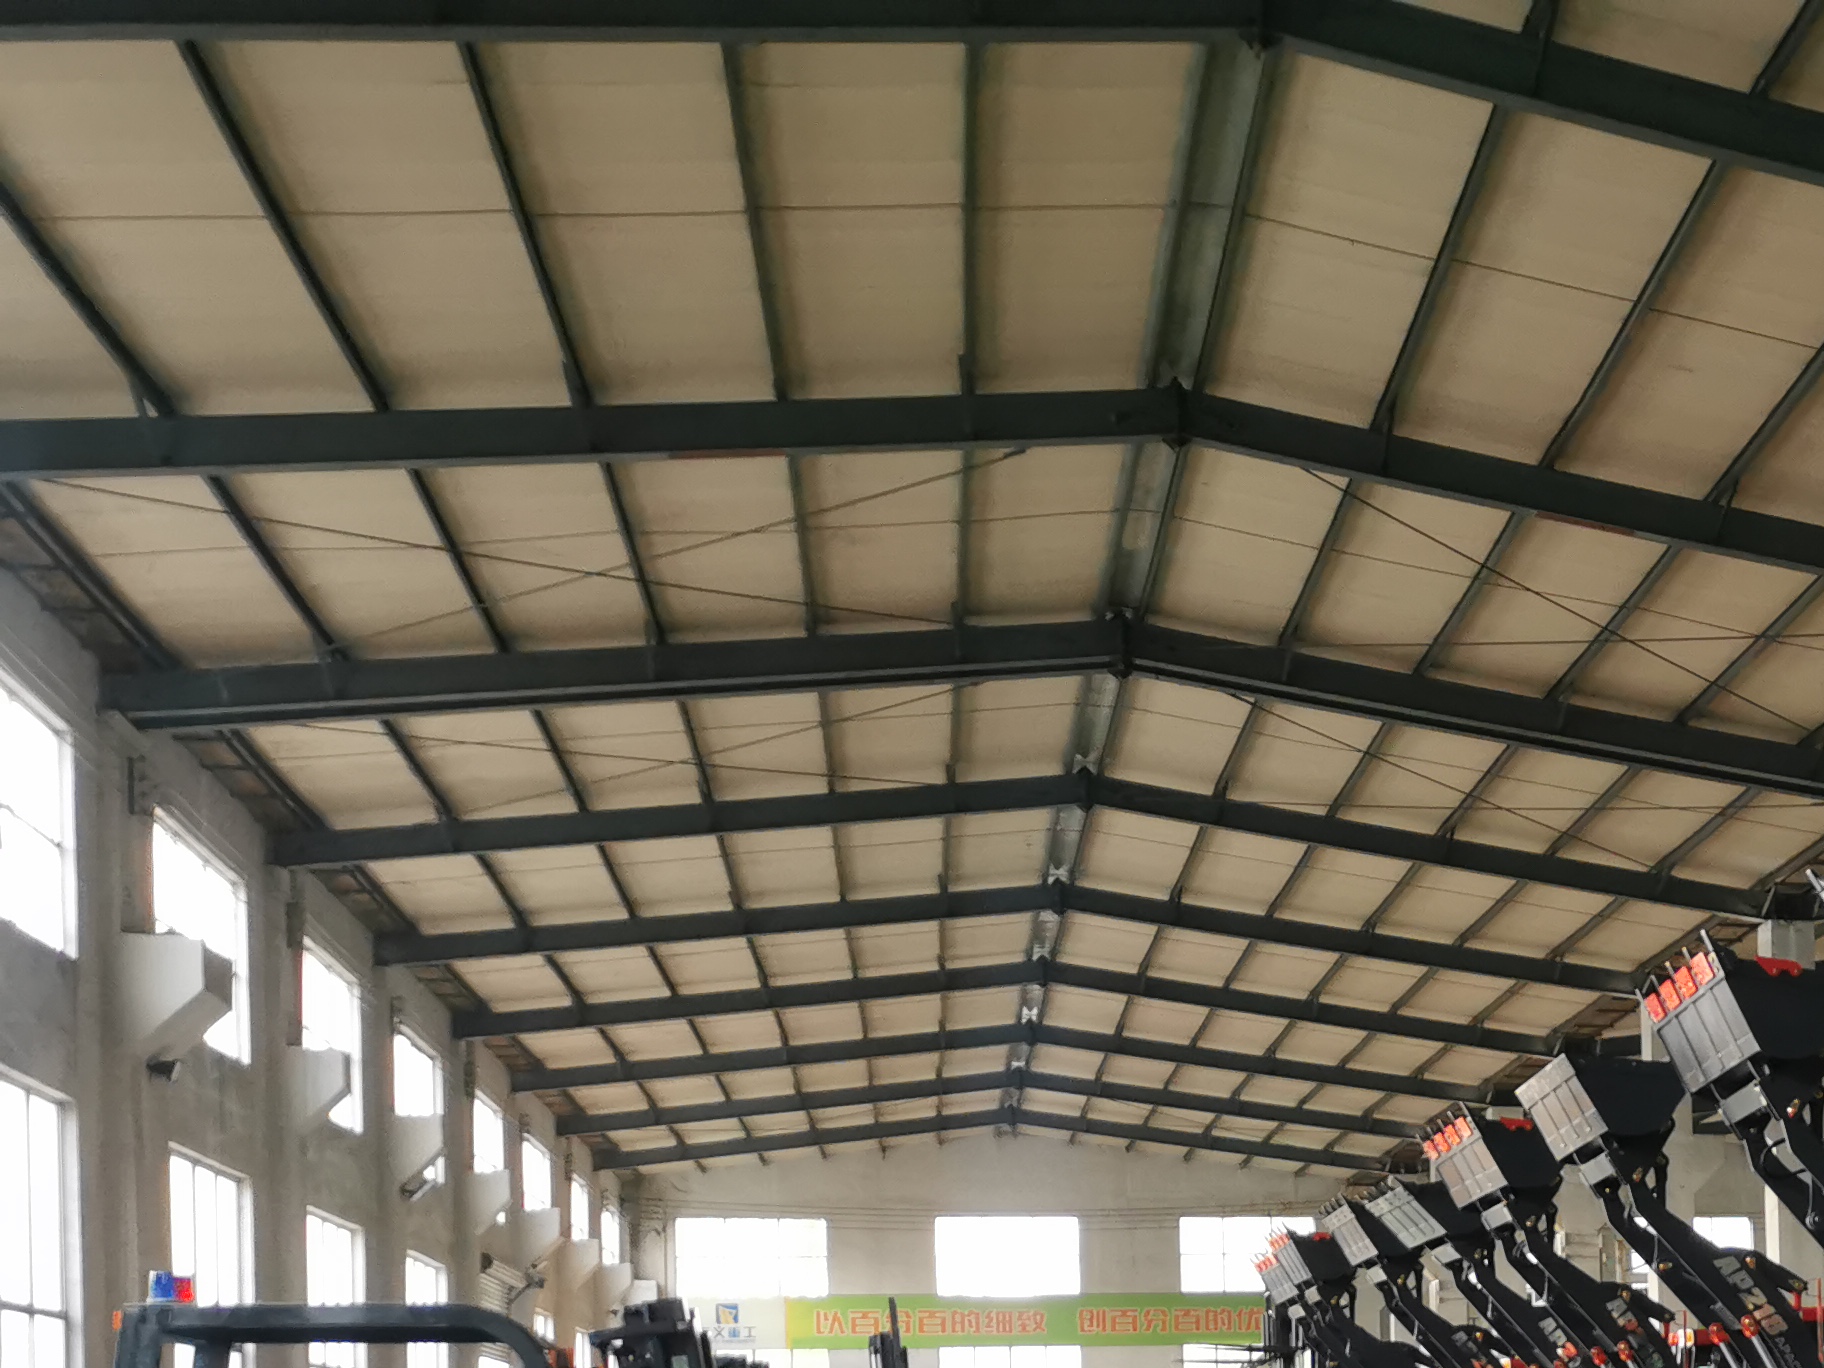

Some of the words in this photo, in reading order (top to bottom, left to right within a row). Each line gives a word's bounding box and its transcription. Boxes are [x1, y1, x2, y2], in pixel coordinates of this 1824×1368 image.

[814, 1309, 1047, 1335] 以百分百的细致
[1077, 1306, 1264, 1333] 创百分百的优
